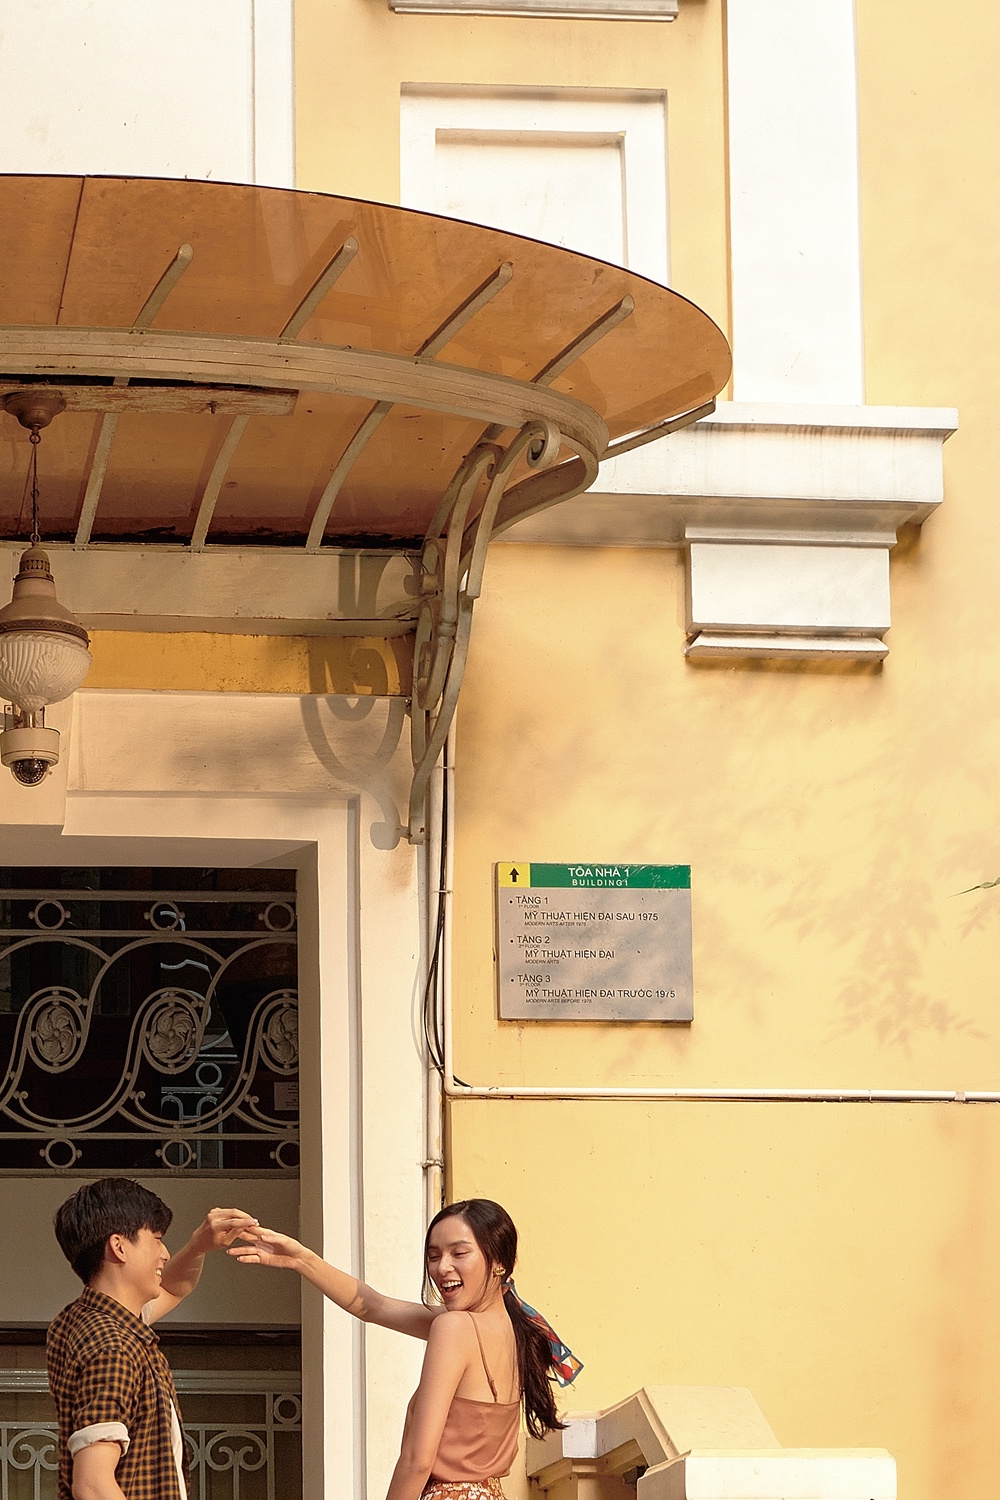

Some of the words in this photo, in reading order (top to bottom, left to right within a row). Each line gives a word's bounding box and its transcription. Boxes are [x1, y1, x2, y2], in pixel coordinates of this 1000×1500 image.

[595, 866, 621, 877] NHÀ
[624, 866, 629, 877] 1
[524, 911, 538, 920] MỸ
[598, 912, 614, 922] ĐẠI
[616, 912, 635, 921] SAU
[638, 913, 659, 921] 1975
[544, 936, 550, 944] 2
[525, 949, 539, 958] MỸ
[599, 950, 615, 960] ĐẠI
[545, 975, 551, 983] 3
[525, 988, 540, 997] MỸ
[600, 990, 616, 999] ĐẠI
